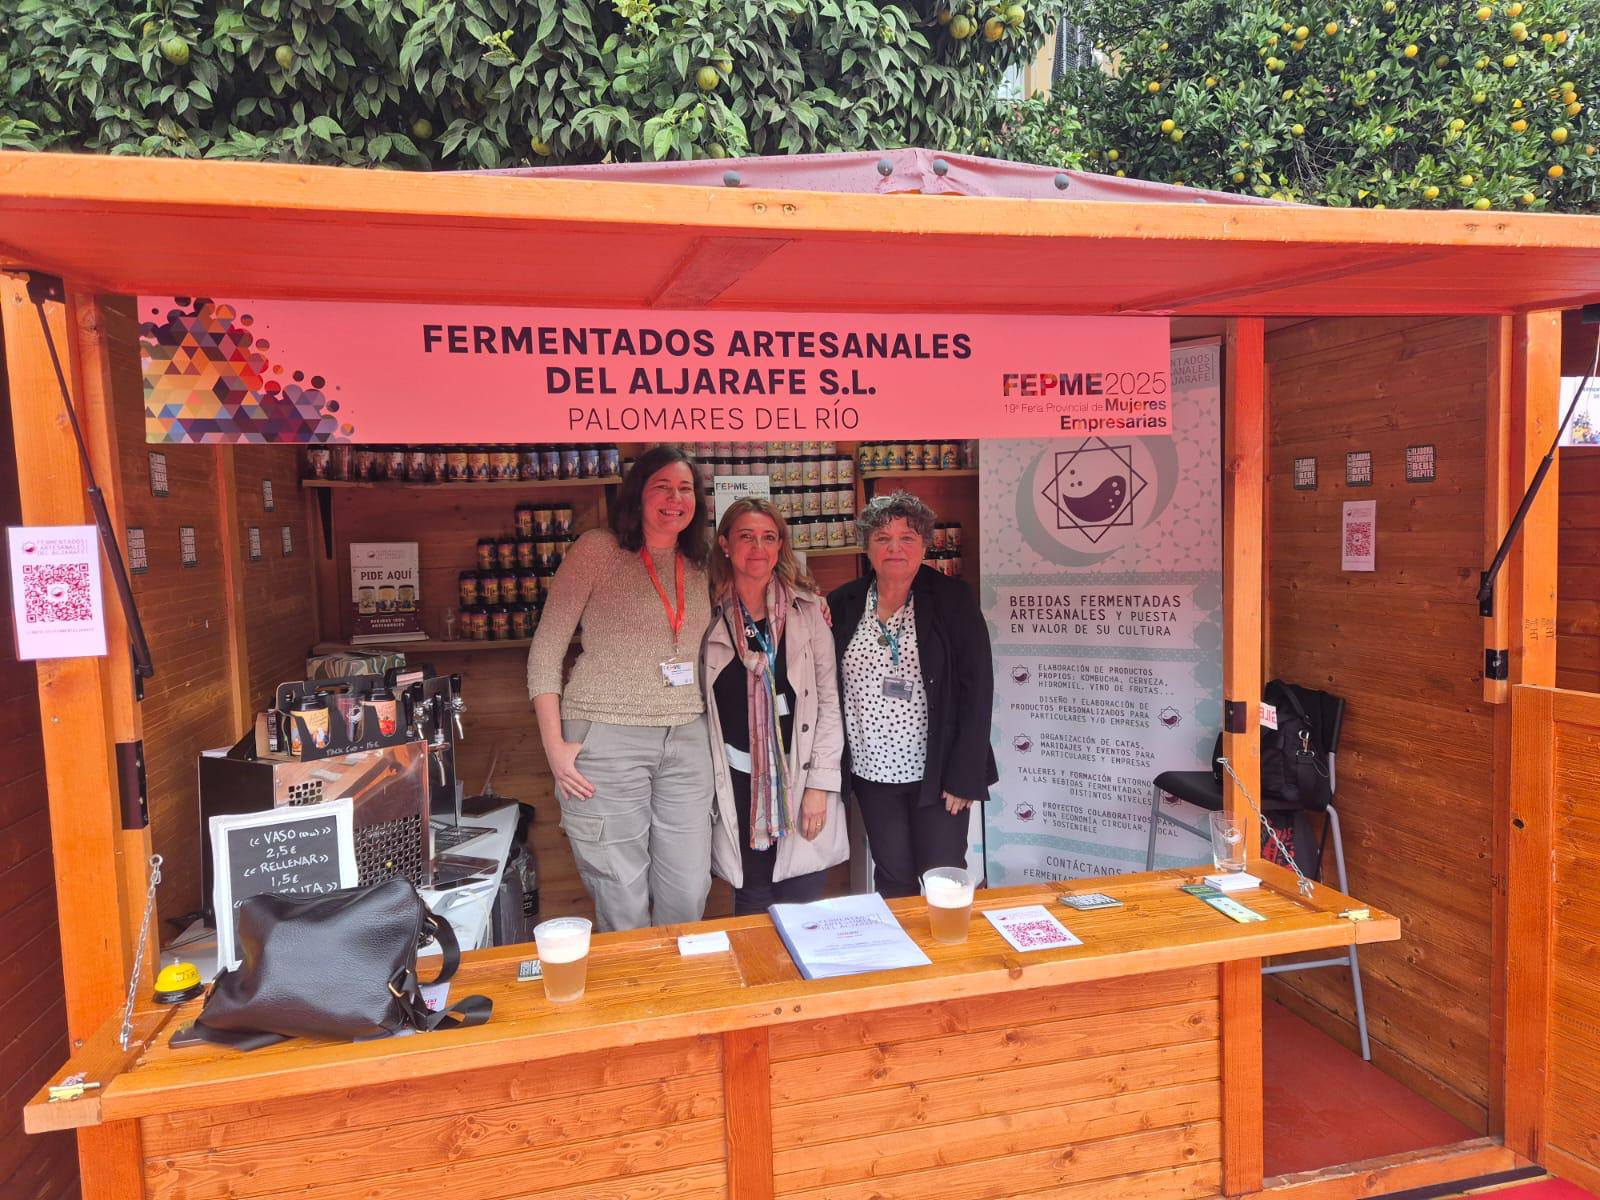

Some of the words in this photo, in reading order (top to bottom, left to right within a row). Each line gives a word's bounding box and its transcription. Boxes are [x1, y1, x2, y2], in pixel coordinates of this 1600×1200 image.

[423, 324, 715, 357] FERMENTADOS
[727, 330, 972, 359] ARTESANALES
[1171, 354, 1210, 366] NTADOS
[1171, 363, 1210, 376] ANALES
[546, 366, 617, 394] DEL
[628, 367, 807, 395] ALJARAFE
[819, 369, 877, 395] S.L.
[1021, 402, 1044, 412] Feria
[1046, 402, 1089, 412] Provincial
[1091, 403, 1103, 412] de
[1105, 397, 1167, 413] Mujeres
[569, 407, 744, 430] PALOMARES
[756, 407, 807, 430] DEL
[816, 399, 859, 430] RÍO
[1060, 414, 1167, 432] Empresarias
[360, 571, 384, 580] PIDE
[387, 568, 412, 580] AQUÍ
[1010, 595, 1071, 607] BEBIDAS
[1080, 595, 1181, 608] FERMENTADAS
[1010, 609, 1106, 621] ARTESANALES
[1116, 611, 1122, 620] Y
[1130, 611, 1177, 622] PUESTA
[1011, 624, 1024, 633] EN
[1032, 624, 1068, 634] VALOR
[1075, 624, 1088, 635] DE
[1096, 624, 1110, 635] SU
[1118, 625, 1171, 636] CULTURA
[1038, 664, 1090, 673] ELABORACIÓN
[1094, 666, 1103, 674] DE
[1109, 667, 1153, 676] PRODUCTOS
[1090, 683, 1111, 692] VINO
[1114, 684, 1124, 692] DE
[1039, 695, 1067, 704] DISEÑO
[1081, 698, 1135, 709] ELABORACIÓN
[1139, 702, 1149, 710] DE
[1011, 703, 1054, 712] PRODUCTOS
[1059, 705, 1125, 717] PERSONALIZADOS
[1130, 710, 1149, 719] PARA
[1030, 712, 1087, 723] PARTICULARES
[1090, 716, 1106, 725] Y/O
[1111, 718, 1150, 729] EMPRESAS
[1040, 733, 1096, 744] ORGANIZACIÓN
[1101, 738, 1111, 746] DE
[1040, 741, 1082, 751] MARIDAJES
[1086, 744, 1091, 752] Y
[1096, 746, 1131, 756] EVENTOS
[1136, 751, 1155, 759] PARA
[1041, 750, 1096, 762] PARTICULARES
[1101, 754, 1106, 762] Y
[1111, 756, 1150, 768] EMPRESAS
[1018, 767, 1056, 776] TALLERES
[1070, 771, 1112, 782] FORMACIÓN
[1117, 776, 1151, 787] ENTORNO
[1033, 776, 1047, 784] LAS
[1052, 777, 1083, 788] BEBIDAS
[1088, 782, 1142, 796] FERMENTADAS
[1070, 788, 1112, 800] DISTINTOS
[1117, 795, 1152, 806] NIVELES
[1042, 802, 1083, 814] PROYECTOS
[1088, 808, 1152, 823] COLABORATIVOS
[1042, 810, 1057, 819] UNA
[1061, 812, 1098, 826] ECONOMÍA
[1157, 828, 1178, 838] OCAL
[1052, 820, 1097, 834] SOSTENIBLE
[263, 829, 296, 845] VASO
[260, 854, 318, 873] RELLENAR
[1046, 855, 1122, 876] CONTÁCTANOS
